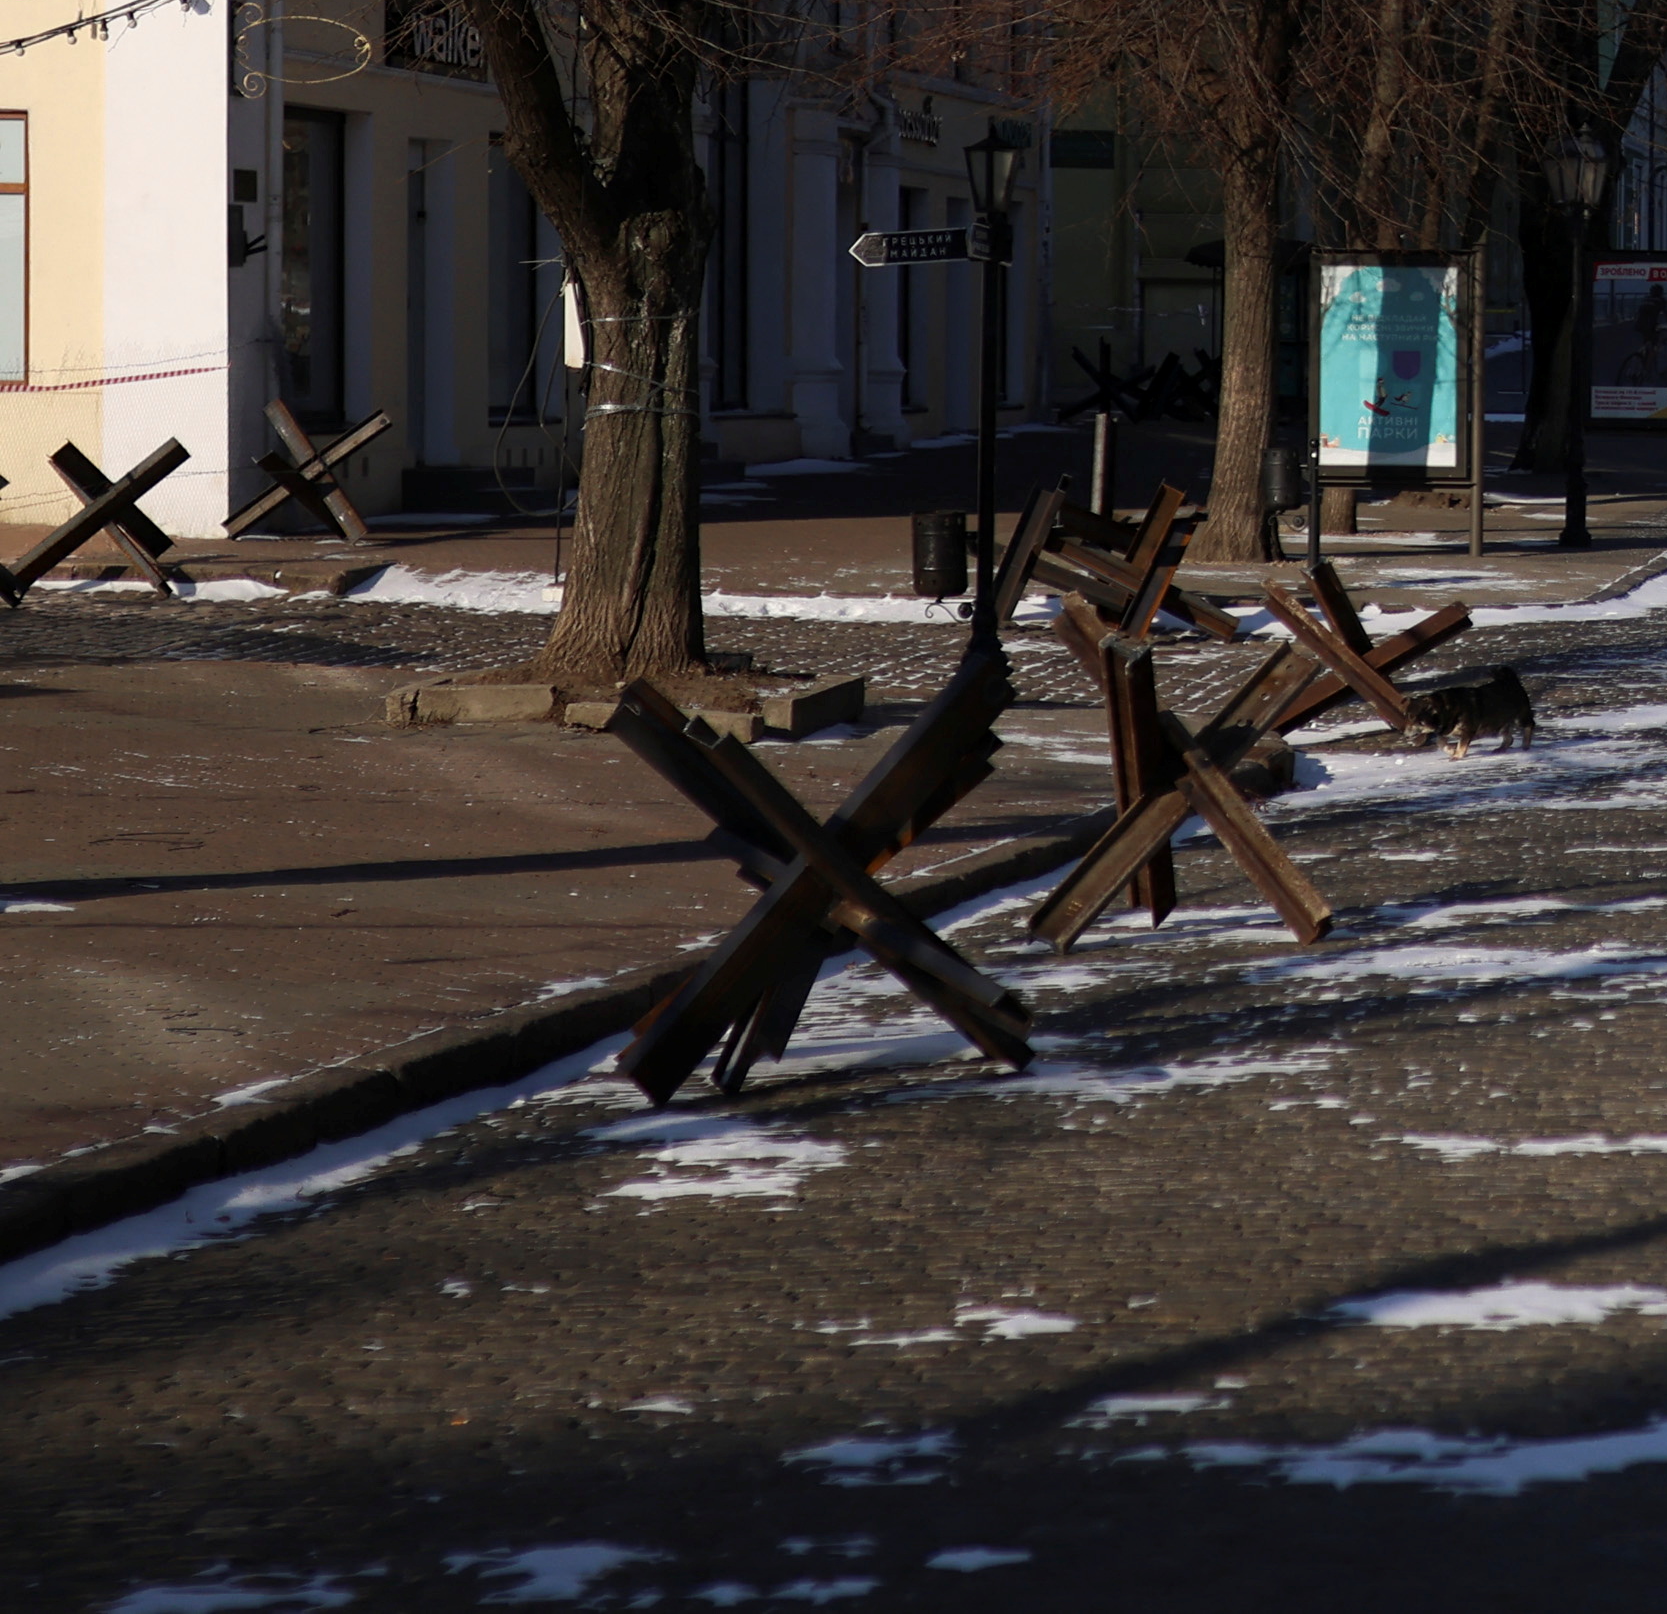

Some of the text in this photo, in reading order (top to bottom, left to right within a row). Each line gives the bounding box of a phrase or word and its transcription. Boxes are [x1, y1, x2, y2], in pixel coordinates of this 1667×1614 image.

[413, 6, 485, 68] walke
[882, 232, 953, 246] ГРЕЦЬКИЙ
[890, 246, 947, 258] МАЙДАН
[1600, 267, 1646, 276] ЗРОБЛЕНО
[1357, 416, 1418, 425] АКТИВНІ
[1357, 428, 1418, 439] ПАРКИ
